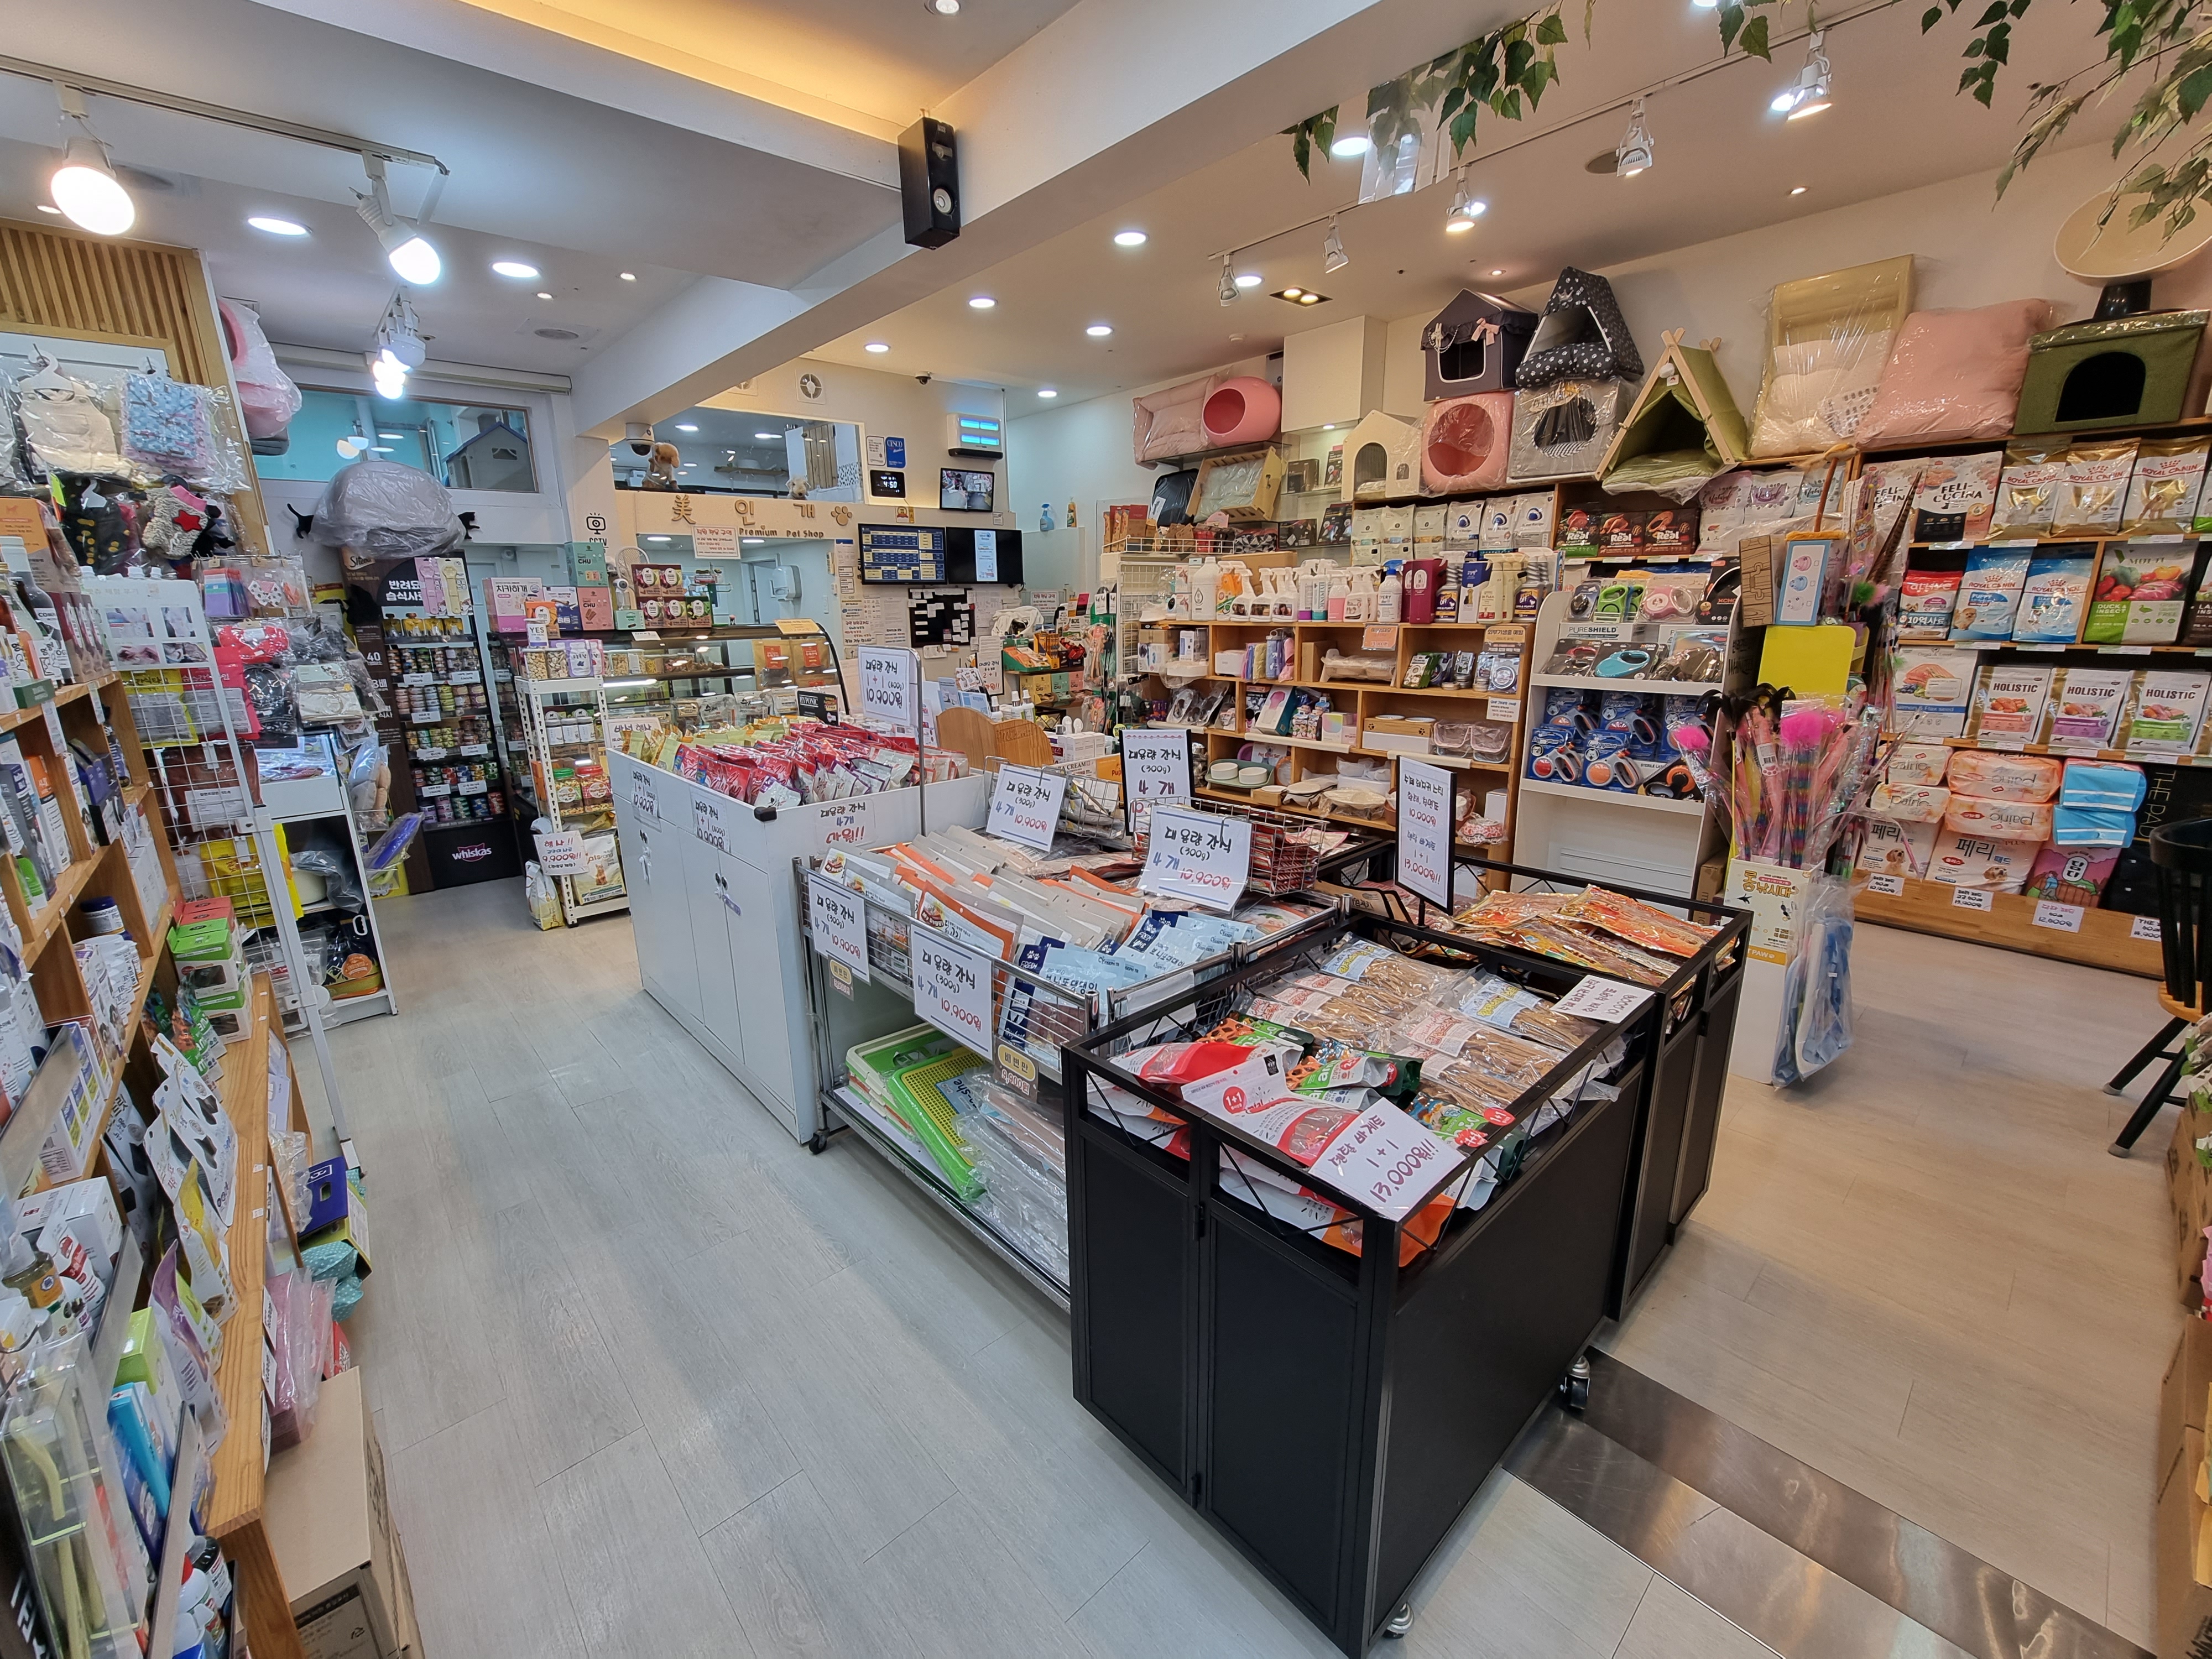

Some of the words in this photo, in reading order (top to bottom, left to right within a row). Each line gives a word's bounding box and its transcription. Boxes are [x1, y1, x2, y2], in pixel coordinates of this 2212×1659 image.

[2142, 467, 2167, 475] ROYAL
[2168, 463, 2198, 474] CANIN
[2007, 476, 2029, 484] ROYAL
[2031, 474, 2057, 483] CANIN
[2069, 473, 2094, 482] ROYAL
[1941, 482, 1973, 494] FELI-
[1933, 491, 1983, 503] CUCINA
[734, 499, 755, 525] 인
[793, 503, 815, 518] 개
[739, 526, 778, 537] Premium
[803, 530, 824, 539] Shop
[1567, 532, 1589, 541] Real
[1610, 533, 1632, 542] Real
[1657, 531, 1679, 540] Real
[497, 584, 528, 593] 치카하개
[1908, 616, 1945, 625] 10억사료
[1569, 626, 1617, 634] PURESHIELD
[367, 651, 381, 661] 40
[865, 660, 883, 672] 대용량
[885, 660, 898, 675] 간식
[1993, 682, 2038, 693] HOLISTIC
[2067, 686, 2115, 697] HOLISTIC
[2146, 688, 2196, 700] HOLISTIC
[1128, 749, 1157, 759] 대용량
[1160, 749, 1181, 761] 간식
[1067, 761, 1087, 770] CREAM
[1141, 764, 1171, 774] (300g)
[1006, 780, 1032, 796] 대용량
[1035, 786, 1051, 802] 간식
[2147, 770, 2177, 801] THE
[1015, 796, 1036, 808] (300g)
[708, 804, 719, 821] 간식
[820, 805, 846, 817] 대용량
[848, 801, 866, 813] 간식
[836, 816, 854, 826] 4개
[1165, 826, 1202, 846] 대용량
[1206, 833, 1232, 854] 간식
[451, 847, 492, 860] whiskas
[1180, 846, 1211, 861] (300g)
[1955, 838, 1996, 862] 페리
[1742, 869, 1794, 898] 롱낚시대
[816, 894, 838, 914] 대용량
[839, 906, 855, 924] 간식
[1752, 949, 1769, 958] PAW
[922, 948, 952, 975] 대용량
[954, 963, 976, 990] 간식
[935, 973, 961, 994] (300g)
[1225, 1092, 1241, 1107] 1+1
[1489, 1111, 1507, 1123] 1+1
[1328, 1143, 1357, 1166] 덴탈
[1354, 1114, 1386, 1145] 바게트
